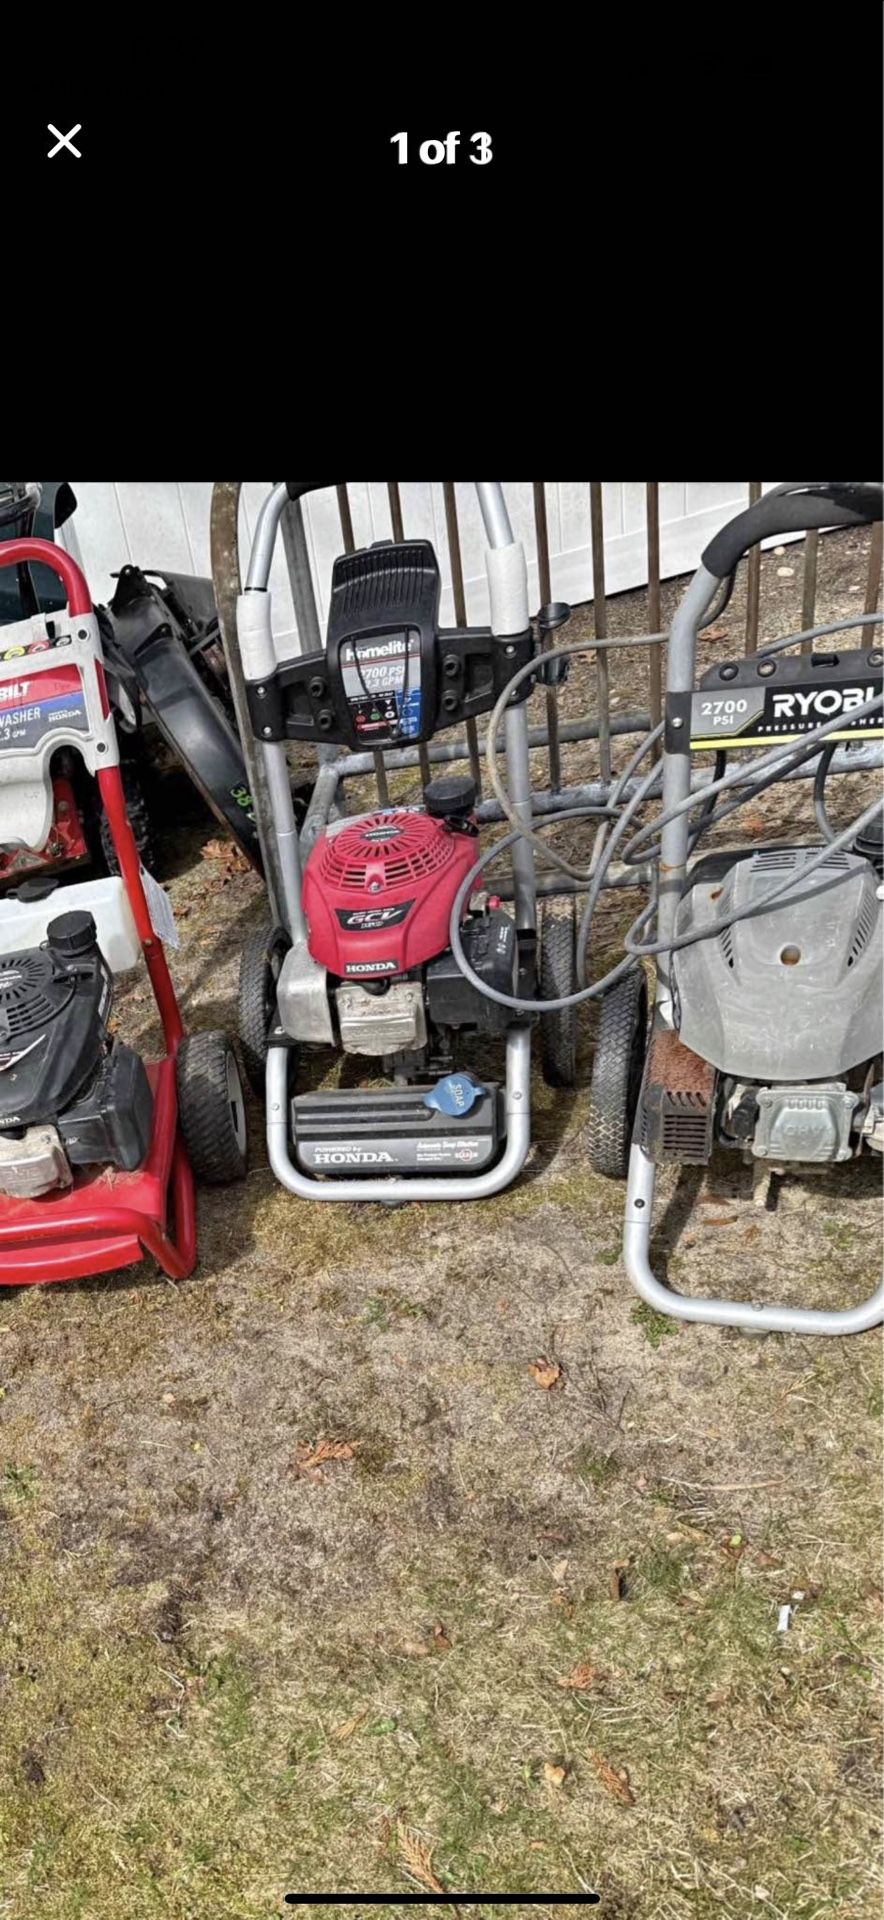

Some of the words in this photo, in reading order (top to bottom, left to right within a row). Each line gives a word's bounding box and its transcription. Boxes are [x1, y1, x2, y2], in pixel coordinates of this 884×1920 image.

[701, 700, 748, 716] 2700
[772, 687, 875, 718] RYOBI
[713, 715, 734, 726] PSI
[757, 721, 822, 733] PRESSURE
[347, 909, 403, 925] GCV
[346, 961, 396, 973] HONDA
[455, 1084, 465, 1107] SOAP
[313, 1152, 394, 1164] HONDA
